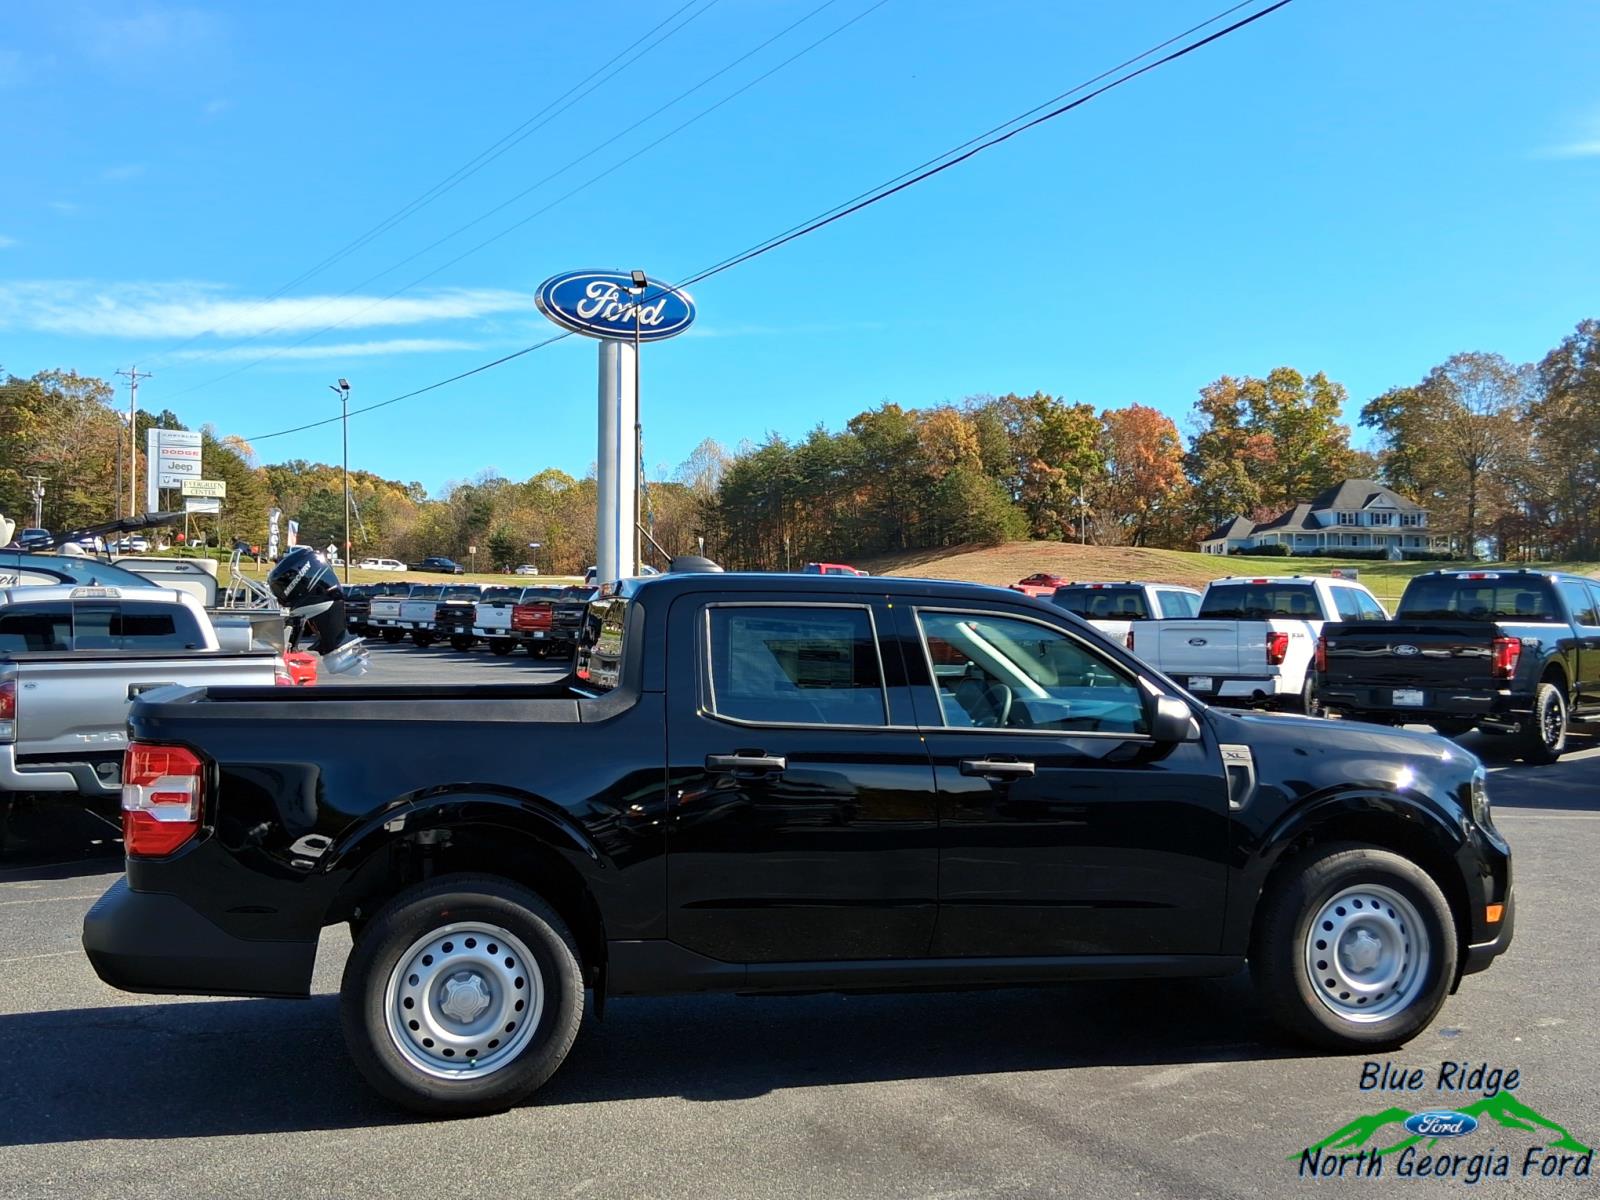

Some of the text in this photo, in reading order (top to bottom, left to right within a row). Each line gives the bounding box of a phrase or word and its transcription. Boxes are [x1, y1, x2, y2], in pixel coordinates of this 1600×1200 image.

[577, 281, 667, 326] Ford
[161, 448, 199, 457] DODGE
[168, 461, 193, 472] Jeep
[183, 480, 224, 490] EVERGREEN
[190, 488, 217, 496] CENTER
[284, 560, 311, 597] MERCURY
